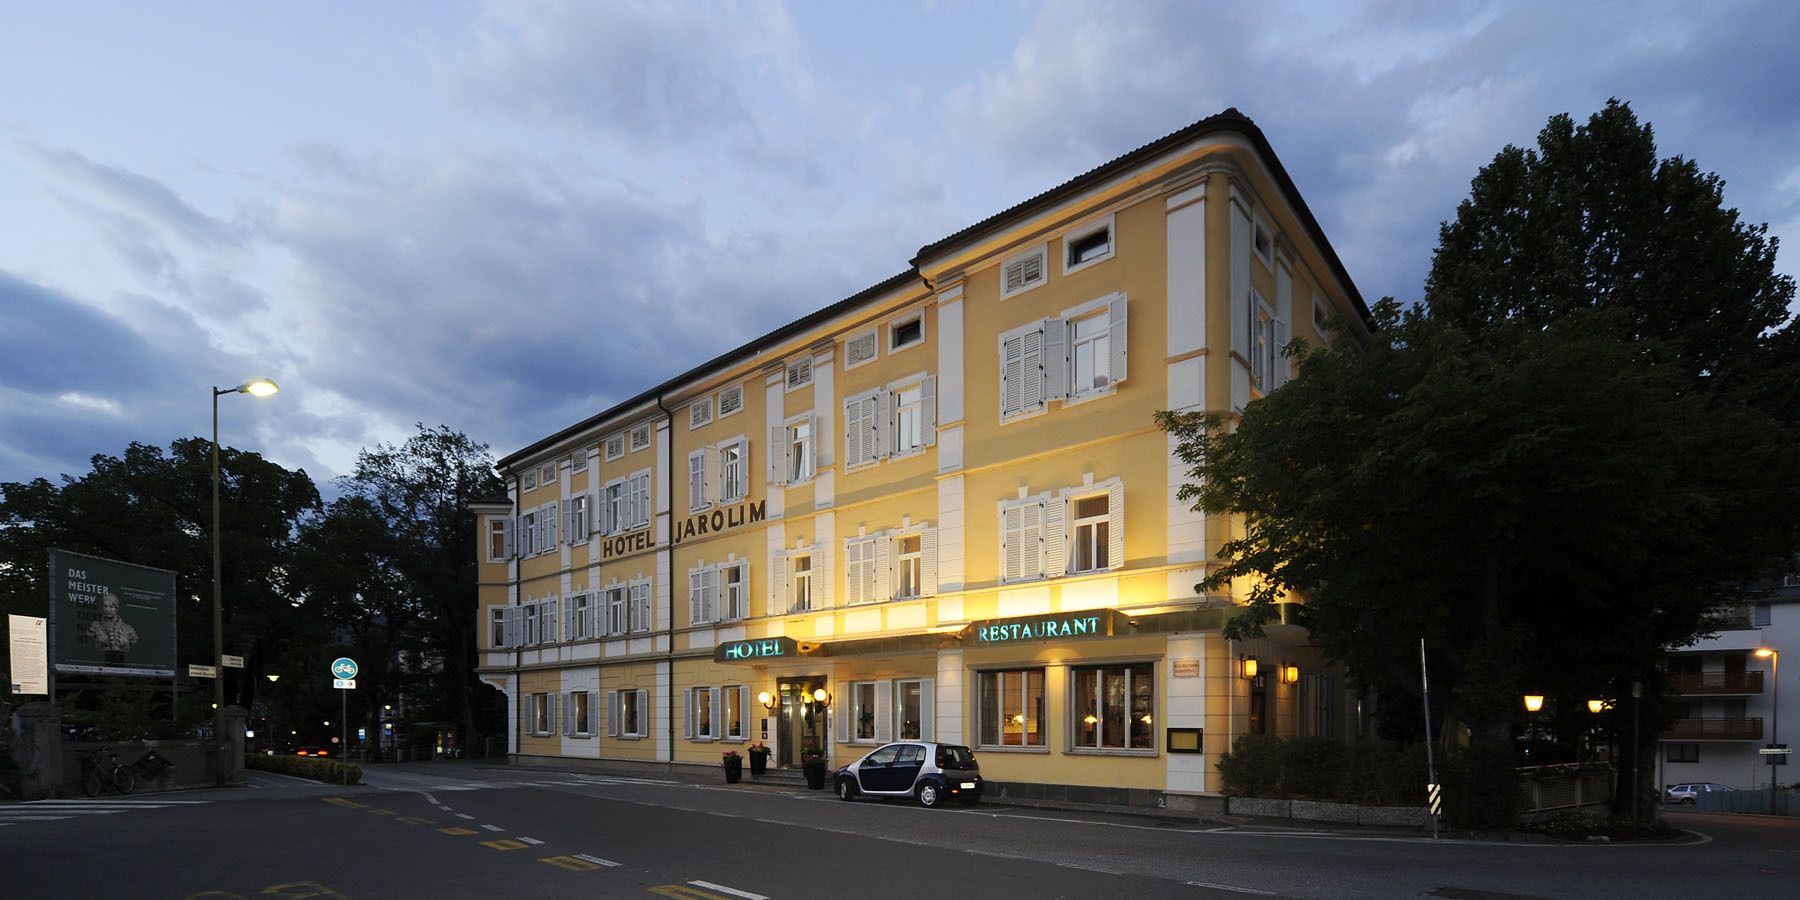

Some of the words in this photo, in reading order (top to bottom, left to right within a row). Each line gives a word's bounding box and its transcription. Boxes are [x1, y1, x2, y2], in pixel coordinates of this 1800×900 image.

[603, 531, 655, 558] HOTEL
[675, 500, 765, 543] JAROLIM
[68, 568, 87, 580] DAS
[68, 580, 109, 595] MEISTER
[68, 592, 96, 605] WERK
[979, 617, 1099, 641] RESTAURANT
[725, 640, 784, 659] HOTEL
